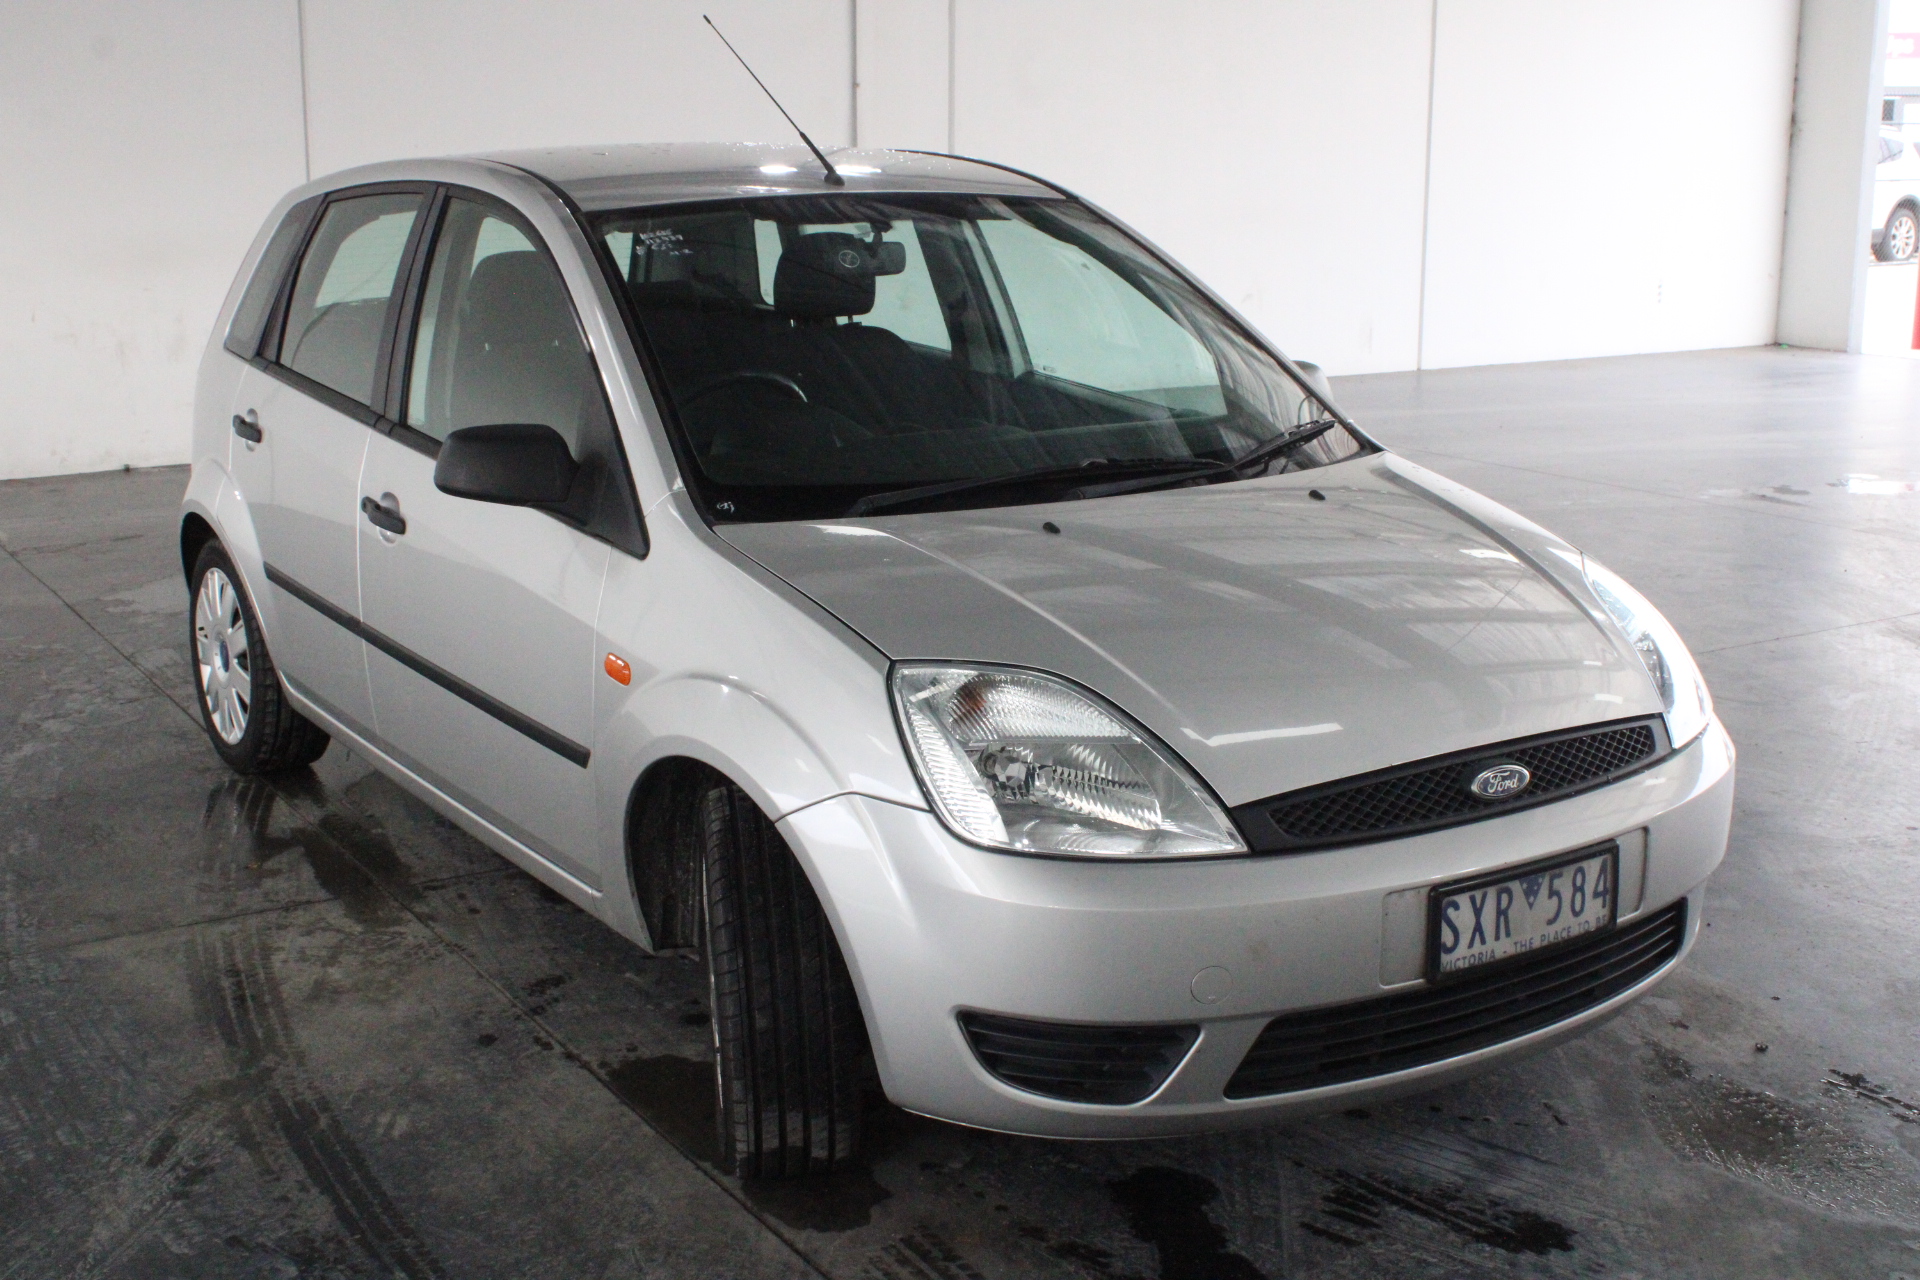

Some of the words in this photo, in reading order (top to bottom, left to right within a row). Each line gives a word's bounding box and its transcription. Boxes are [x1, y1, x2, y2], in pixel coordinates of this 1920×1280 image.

[1487, 771, 1519, 793] Ford
[1441, 886, 1514, 955] SXR
[1546, 856, 1610, 926] 584
[1441, 948, 1496, 973] VICTORIA
[1513, 937, 1534, 953] THE
[1539, 926, 1572, 946] PLACE
[1577, 919, 1591, 933] TO
